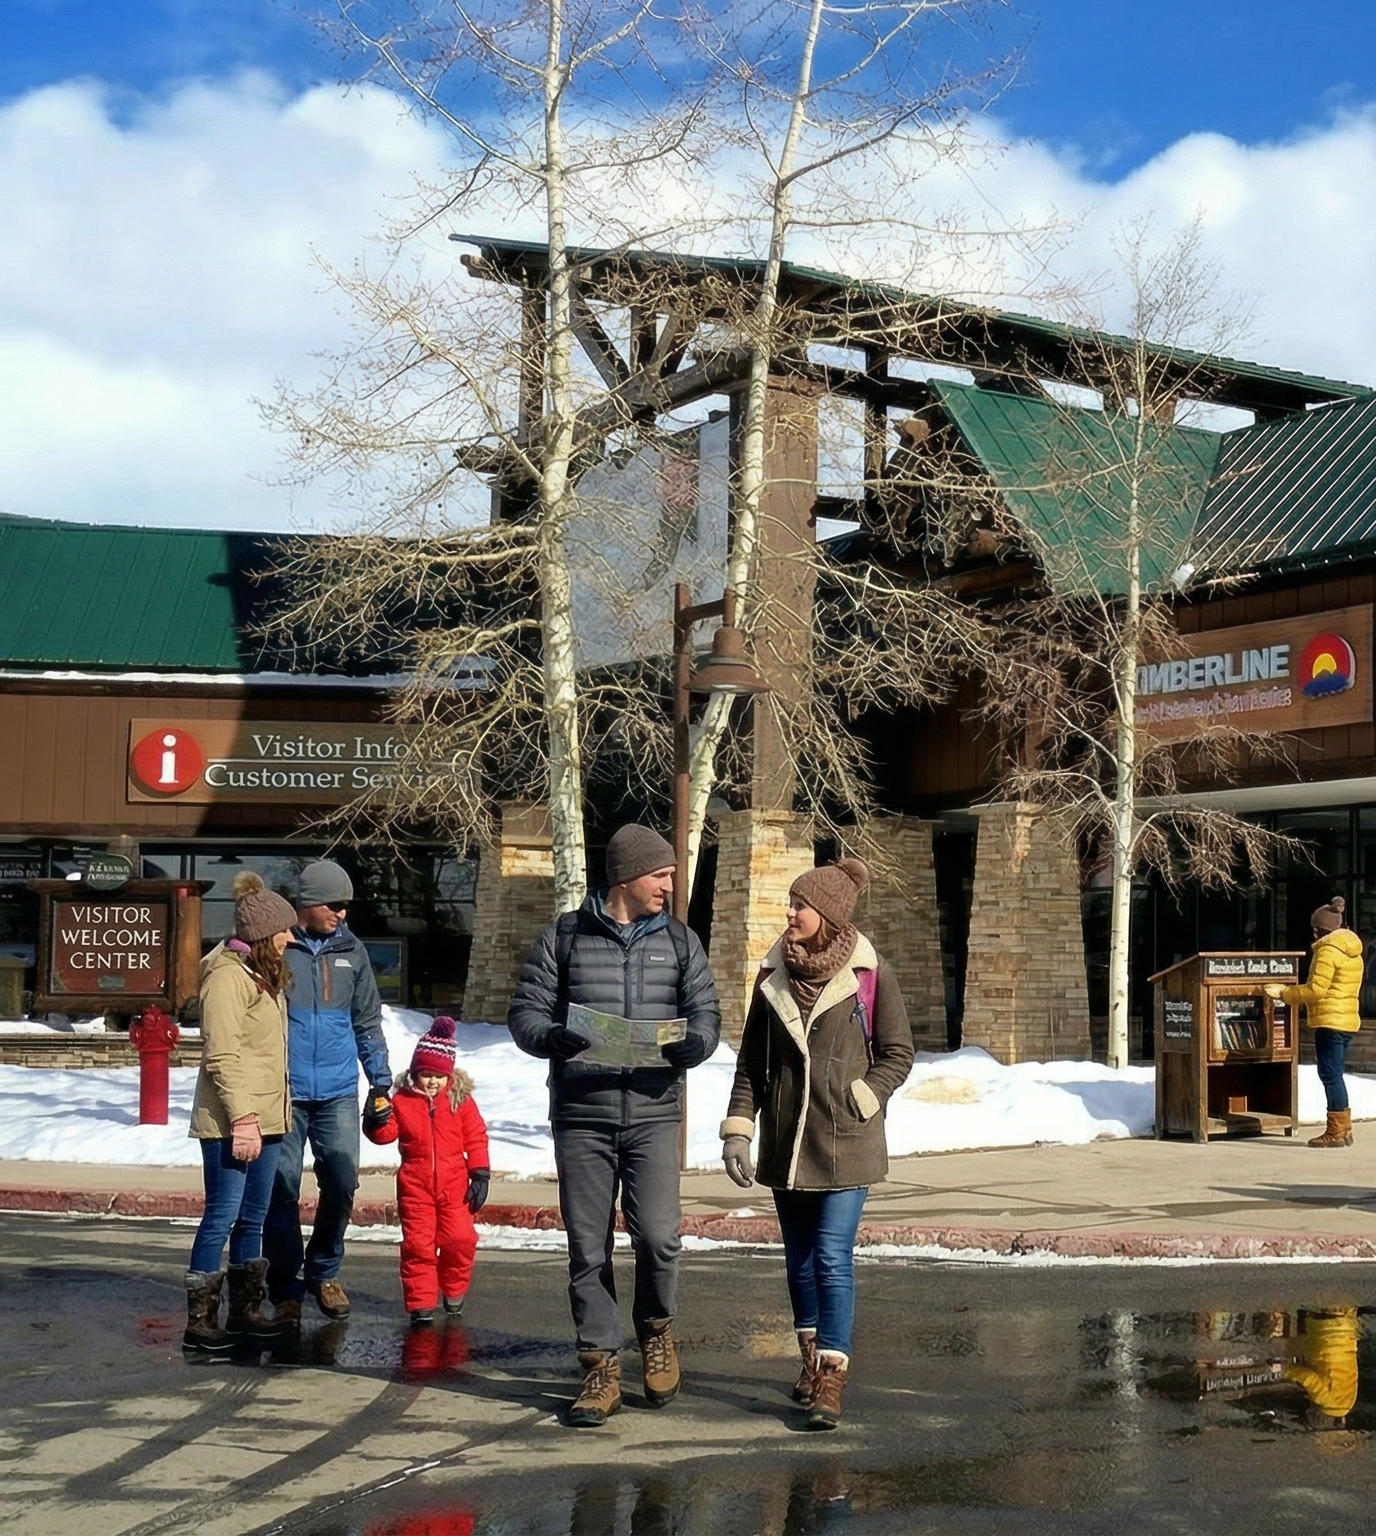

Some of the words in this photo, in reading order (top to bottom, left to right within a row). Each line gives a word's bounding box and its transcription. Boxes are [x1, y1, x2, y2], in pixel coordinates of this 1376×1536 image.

[252, 734, 346, 759] Visitor
[353, 736, 411, 759] Info
[204, 763, 347, 789] Customer
[71, 906, 152, 924] VISITOR
[61, 929, 162, 946] WELCOME
[70, 952, 151, 969] CENTER
